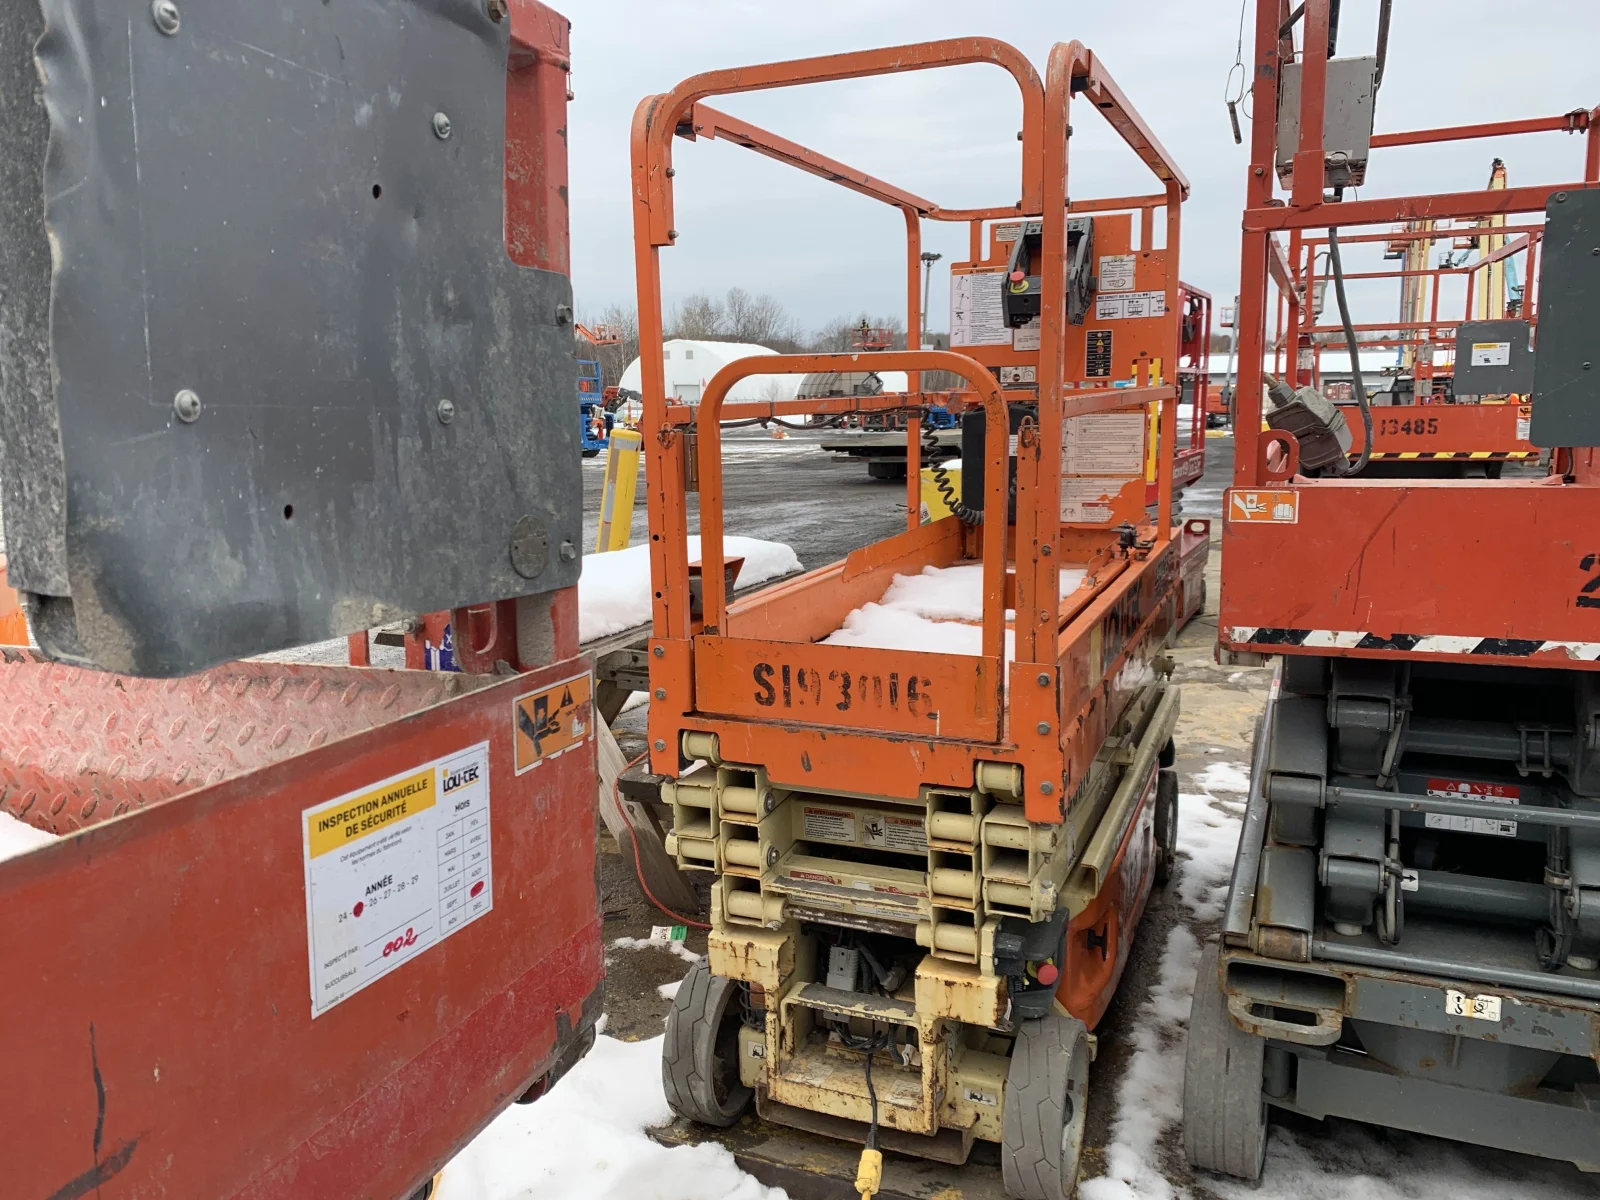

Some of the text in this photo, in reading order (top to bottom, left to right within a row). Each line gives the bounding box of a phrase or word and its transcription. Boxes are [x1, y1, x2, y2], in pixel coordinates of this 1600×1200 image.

[1380, 418, 1438, 436] 13485
[443, 766, 480, 793] LOU-TEC
[318, 778, 428, 832] INSPECTION ANNUELLE
[455, 800, 470, 812] MOIS
[345, 800, 407, 838] DE SÉCURITÉ
[365, 874, 393, 896] ANNÉE
[444, 879, 460, 894] JUILLET
[338, 874, 419, 923] 24 26 27 28 29
